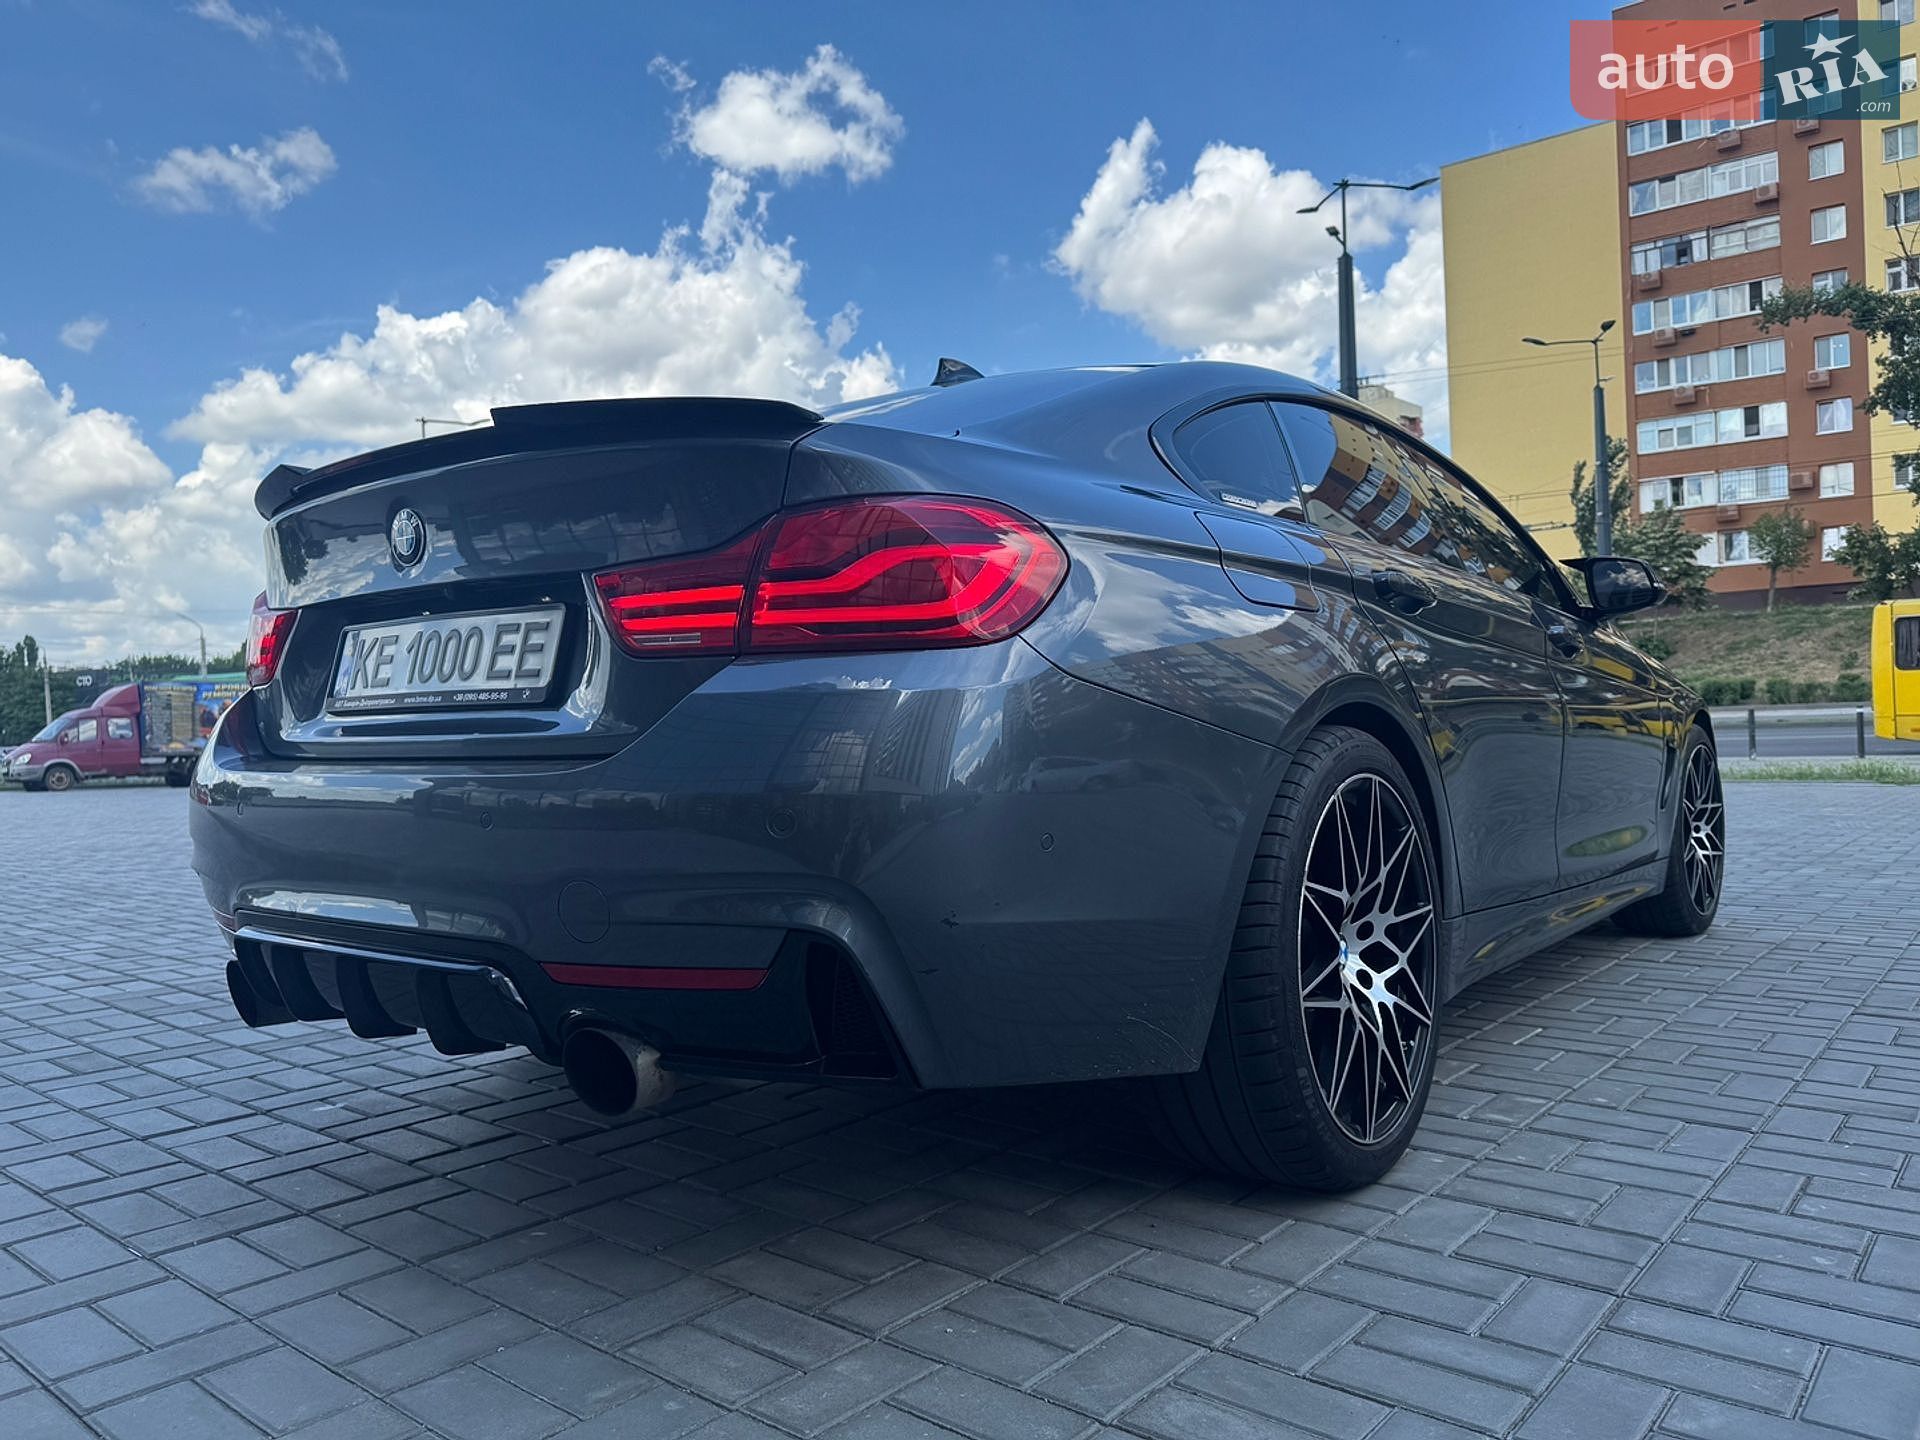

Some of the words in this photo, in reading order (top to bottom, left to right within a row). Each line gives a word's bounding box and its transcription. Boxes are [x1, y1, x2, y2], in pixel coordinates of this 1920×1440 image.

[350, 633, 399, 690] KE
[405, 626, 483, 685] 1000
[486, 620, 551, 681] EE
